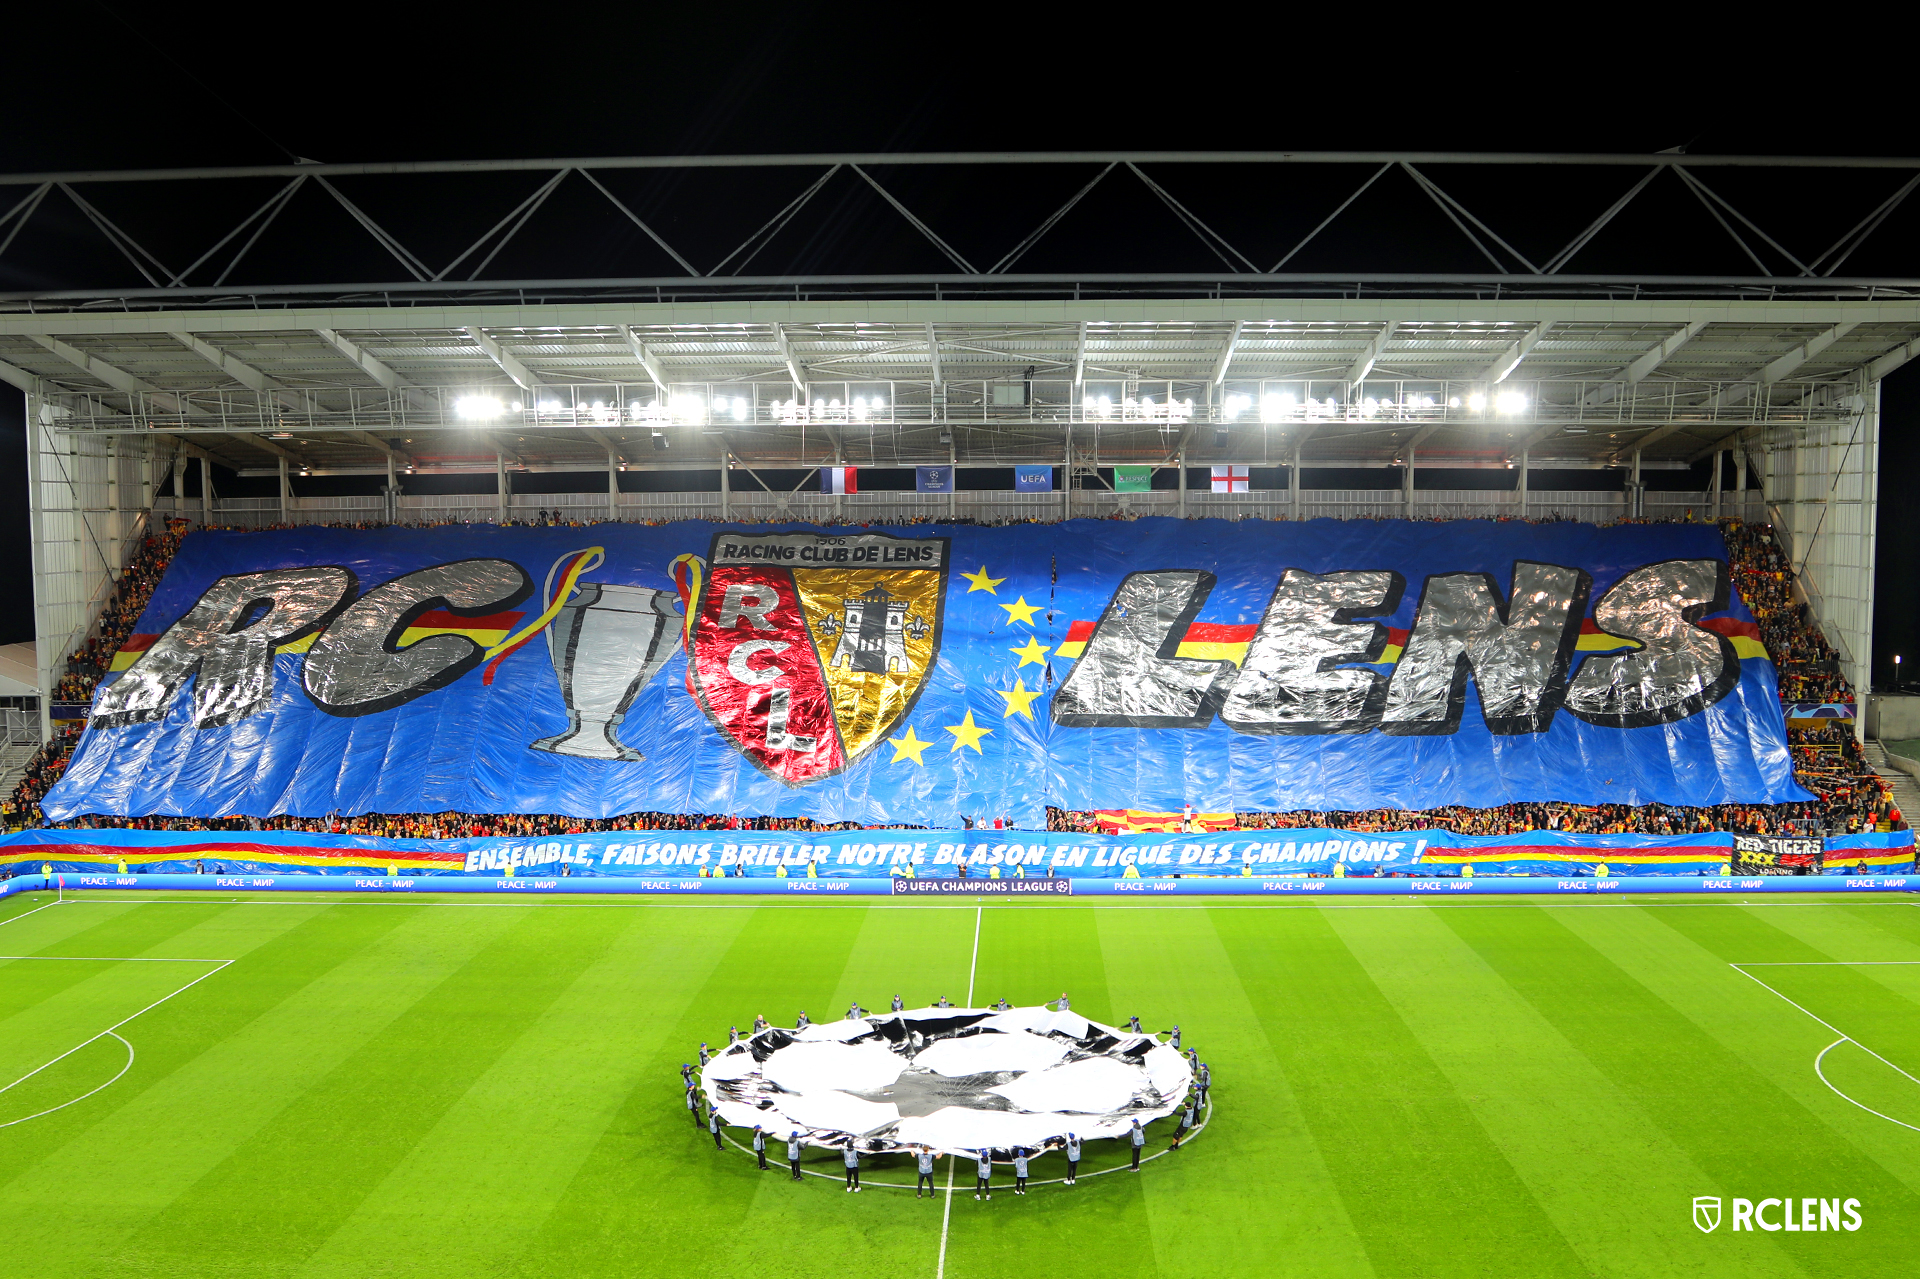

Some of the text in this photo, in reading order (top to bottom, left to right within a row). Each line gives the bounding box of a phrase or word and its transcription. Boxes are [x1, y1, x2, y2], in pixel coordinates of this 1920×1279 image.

[1020, 475, 1046, 483] UEFA
[815, 537, 847, 546] 1906
[722, 543, 934, 563] RACING CLUB DE LENS
[91, 557, 1742, 736] RC LENS
[1735, 836, 1821, 855] RED TIGERS
[464, 843, 594, 872] ENSEMBLE,
[601, 843, 713, 866] FAISONS
[719, 844, 831, 867] BRILLER
[836, 842, 928, 866] NOTRE
[932, 843, 1048, 866] BLASON
[1051, 846, 1090, 867] EN
[1091, 844, 1174, 867] LIGUE
[1178, 844, 1235, 866] DES
[1241, 839, 1406, 865] CHAMPIONS
[1760, 867, 1794, 876] LOADING
[80, 876, 108, 886] PEACE
[116, 877, 138, 886] МИР
[216, 877, 245, 887] PEACE
[252, 878, 275, 887] МИР
[355, 879, 384, 888] PEACE
[392, 879, 415, 888] МИР
[496, 880, 526, 889] PEACE
[534, 880, 558, 889] МИР
[641, 880, 671, 890] PEACE
[679, 880, 703, 890] МИР
[787, 881, 818, 891] PEACE
[826, 881, 850, 891] МИР
[1114, 881, 1145, 891] PEACE
[1153, 882, 1177, 891] МИР
[1262, 881, 1294, 891] PEACE
[1302, 881, 1326, 891] МИР
[1411, 880, 1442, 891] PEACE
[1450, 881, 1474, 890] МИР
[1557, 880, 1588, 890] PEACE
[1596, 880, 1620, 890] МИР
[1702, 879, 1733, 889] PEACE
[1740, 879, 1764, 889] МИР
[1846, 878, 1876, 888] PEACE
[1883, 878, 1907, 887] МИР
[909, 881, 1054, 892] UEFA CHAMPIONS LEAGUE
